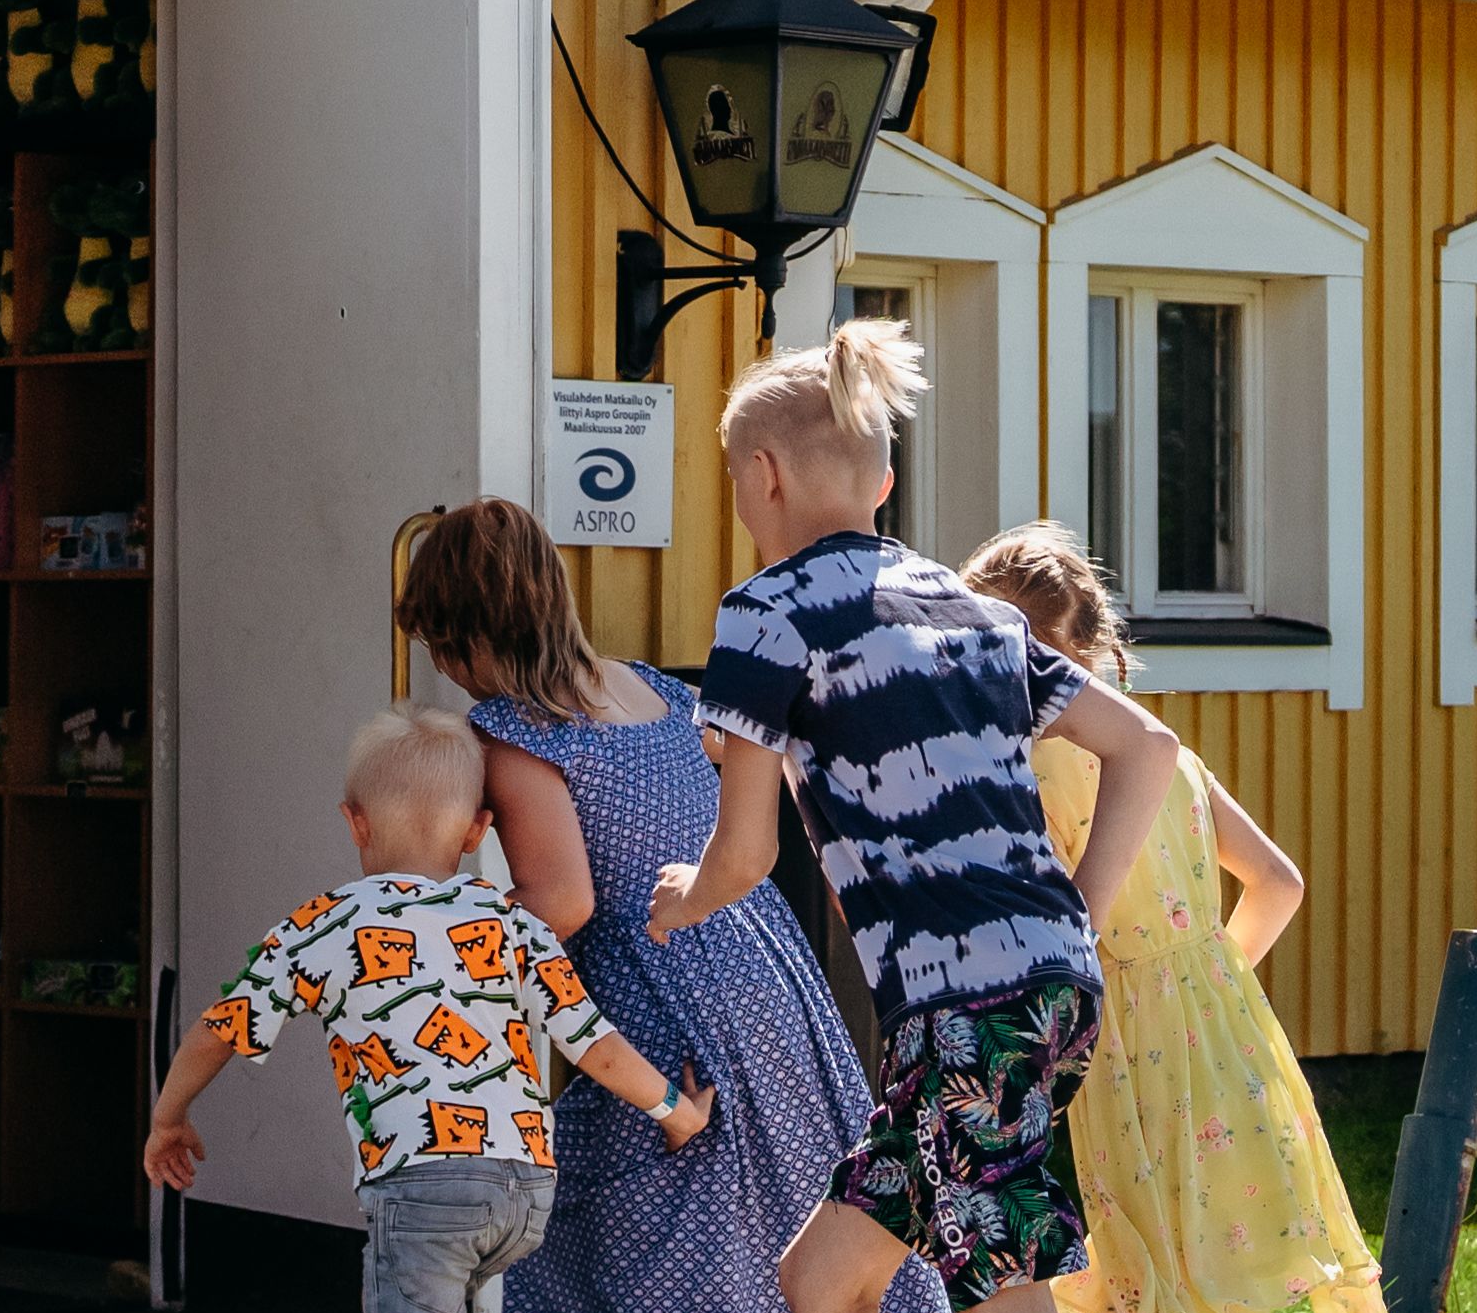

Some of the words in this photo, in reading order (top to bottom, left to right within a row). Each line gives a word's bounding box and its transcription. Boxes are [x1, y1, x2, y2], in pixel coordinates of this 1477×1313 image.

[554, 392, 603, 404] Visulahden
[605, 395, 644, 406] Matkailu
[645, 396, 657, 409] Oy
[559, 406, 583, 420] liittyi
[584, 408, 611, 422] Aspro
[612, 409, 651, 423] Groupiin
[563, 422, 623, 434] Maaliskuussa
[624, 424, 646, 435] 2007
[573, 510, 636, 533] ASPRO
